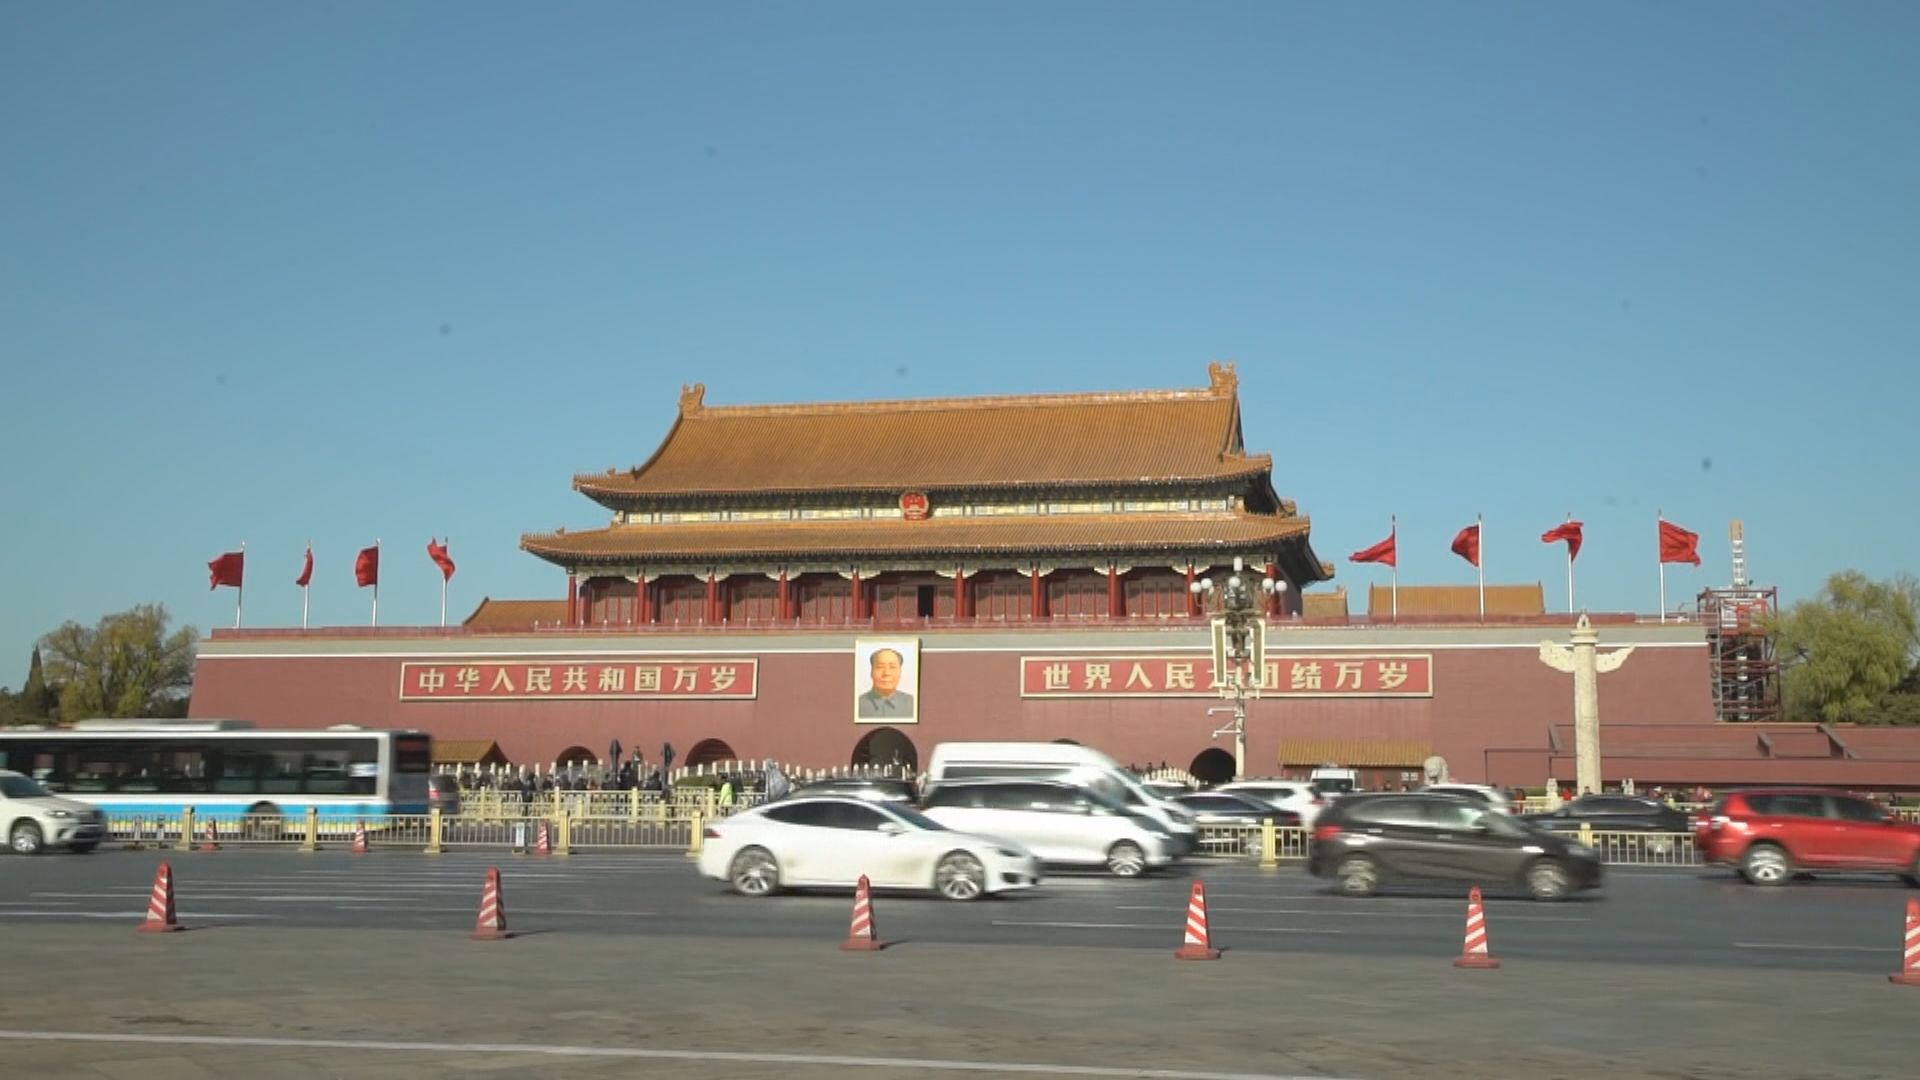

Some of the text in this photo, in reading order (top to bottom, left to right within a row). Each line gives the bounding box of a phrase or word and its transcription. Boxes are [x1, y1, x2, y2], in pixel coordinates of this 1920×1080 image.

[419, 666, 737, 693] 中华人民共和国万岁
